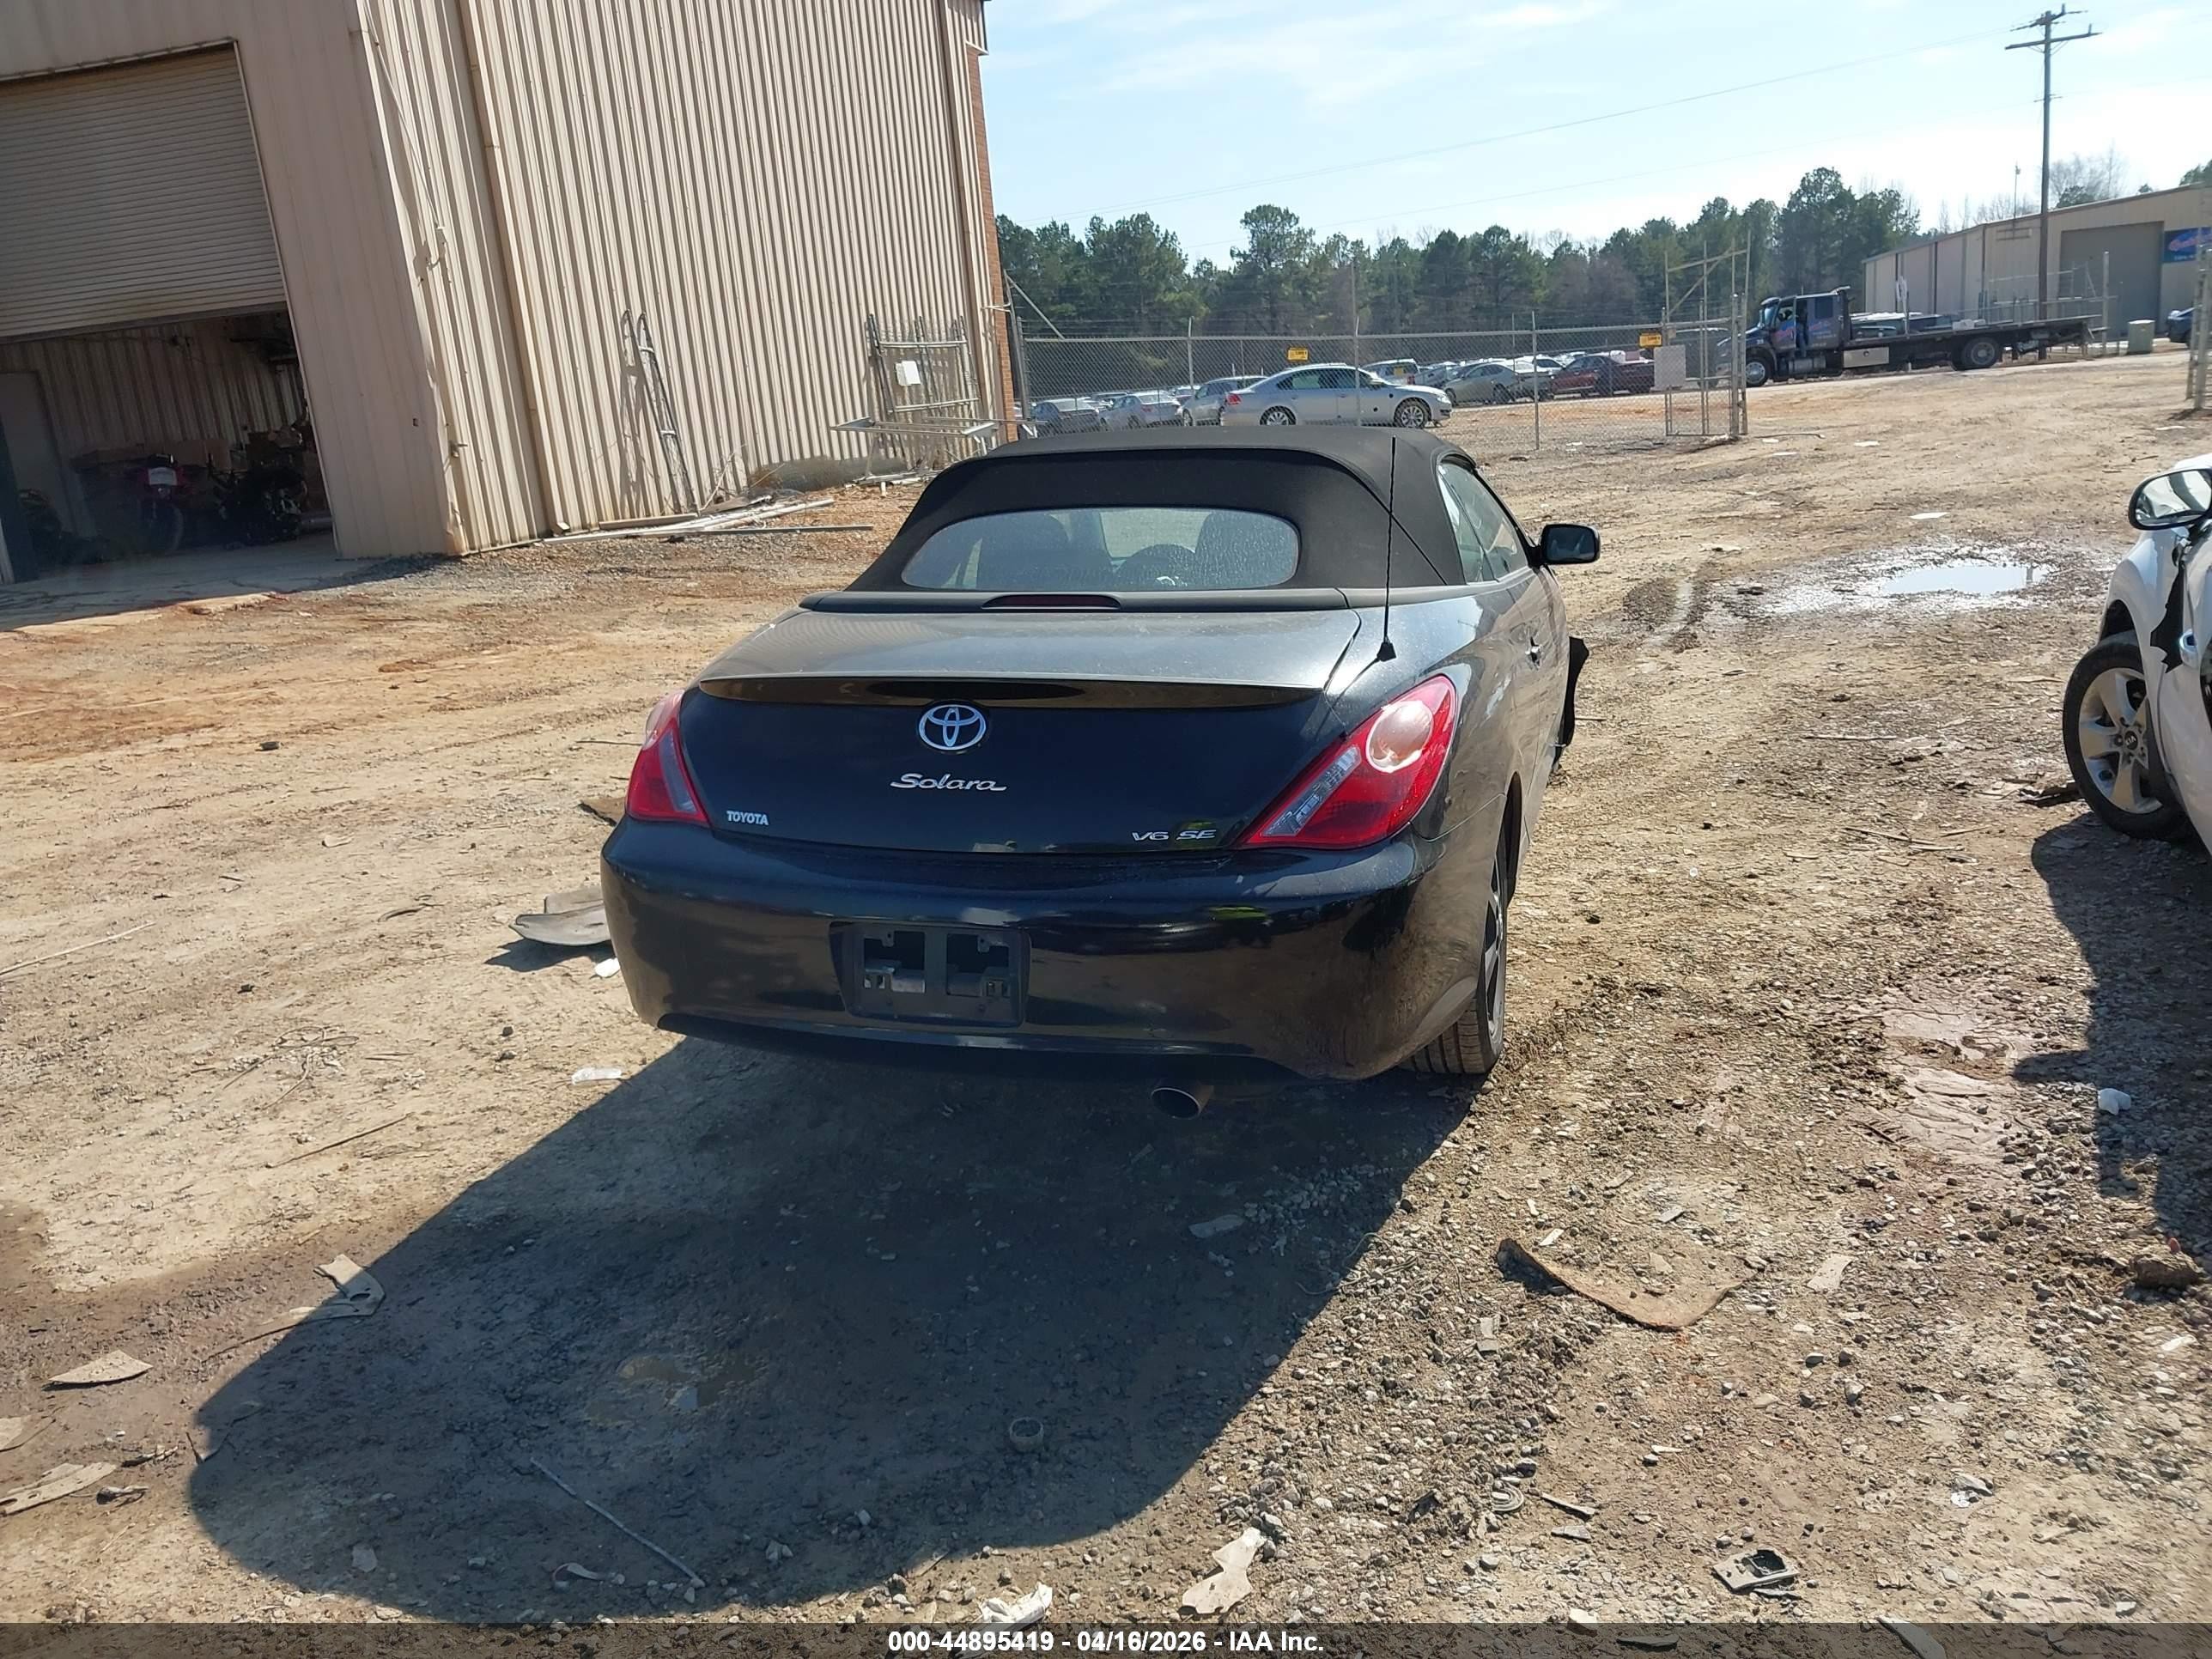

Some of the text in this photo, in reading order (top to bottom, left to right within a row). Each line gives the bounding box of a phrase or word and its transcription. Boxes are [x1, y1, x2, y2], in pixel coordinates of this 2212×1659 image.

[890, 773, 1007, 791] Solara
[726, 810, 770, 825] TOYOTA
[1131, 830, 1217, 842] V6 SE
